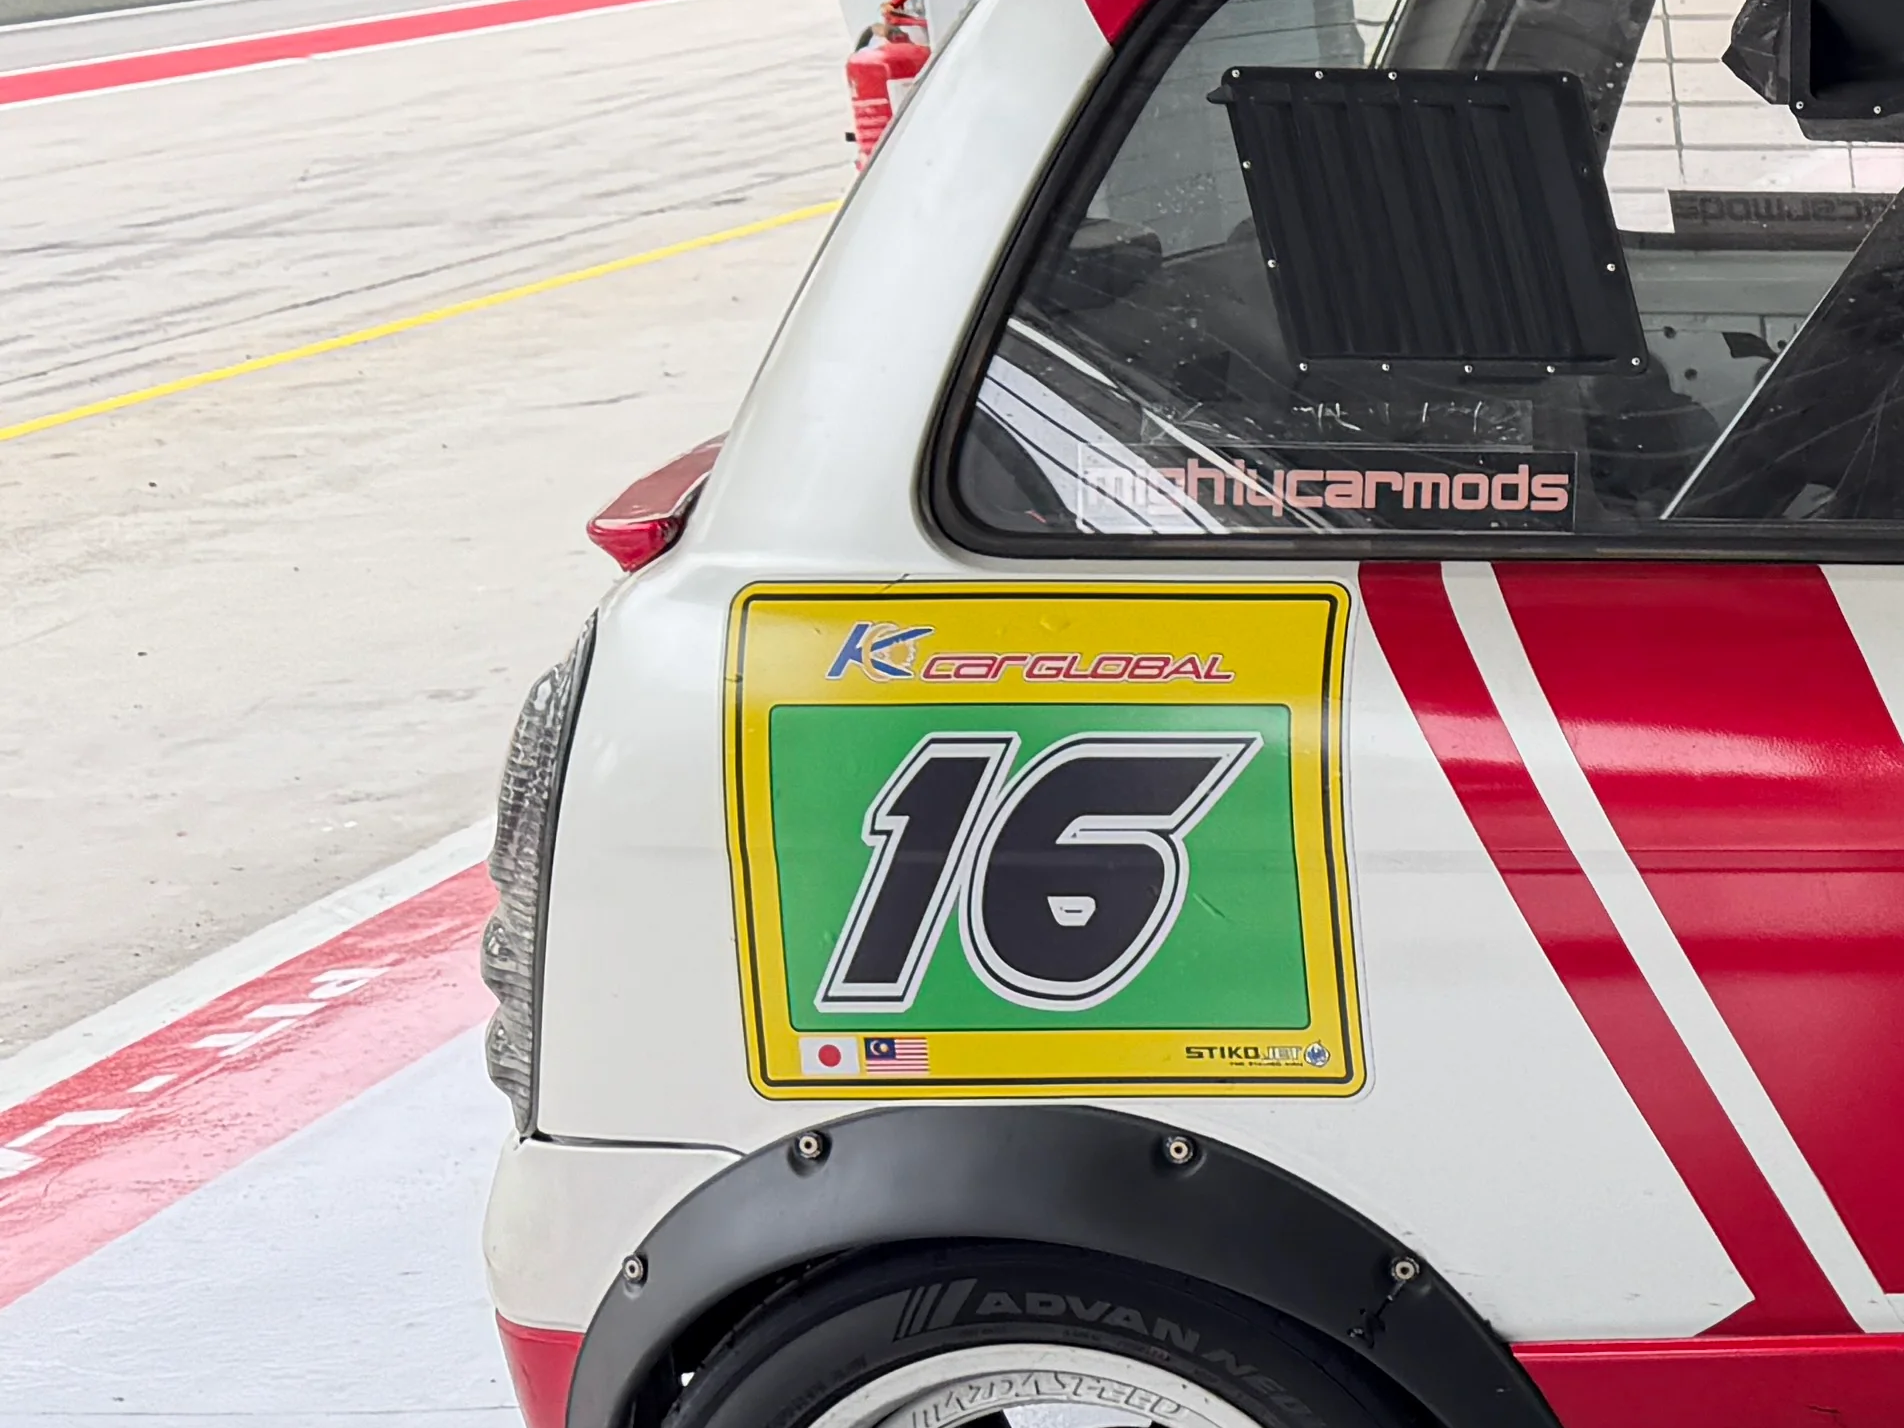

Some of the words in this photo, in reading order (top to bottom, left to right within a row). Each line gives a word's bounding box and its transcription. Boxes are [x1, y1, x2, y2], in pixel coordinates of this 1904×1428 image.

[1082, 458, 1570, 517] mightycarmods
[814, 732, 1264, 1013] 16
[976, 1288, 1200, 1352] ADVAN
